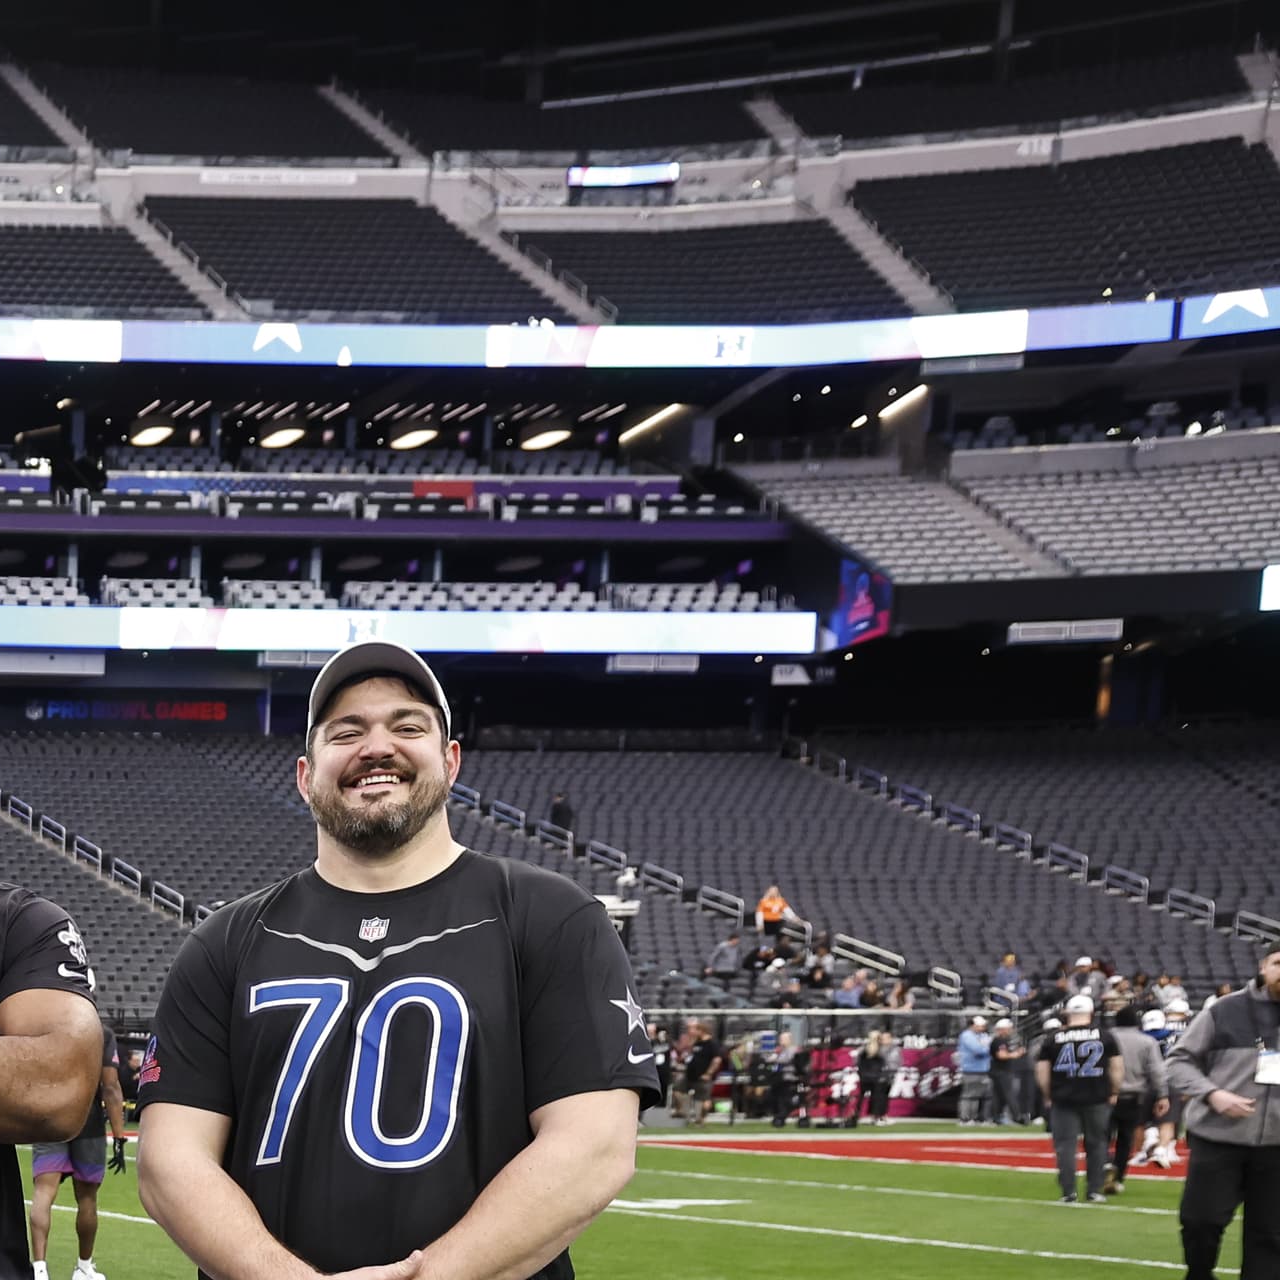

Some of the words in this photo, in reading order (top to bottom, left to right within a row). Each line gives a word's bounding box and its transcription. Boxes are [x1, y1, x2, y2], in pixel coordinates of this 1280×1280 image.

[155, 701, 228, 721] GAMES
[249, 976, 470, 1169] 70
[1052, 1040, 1105, 1078] 42
